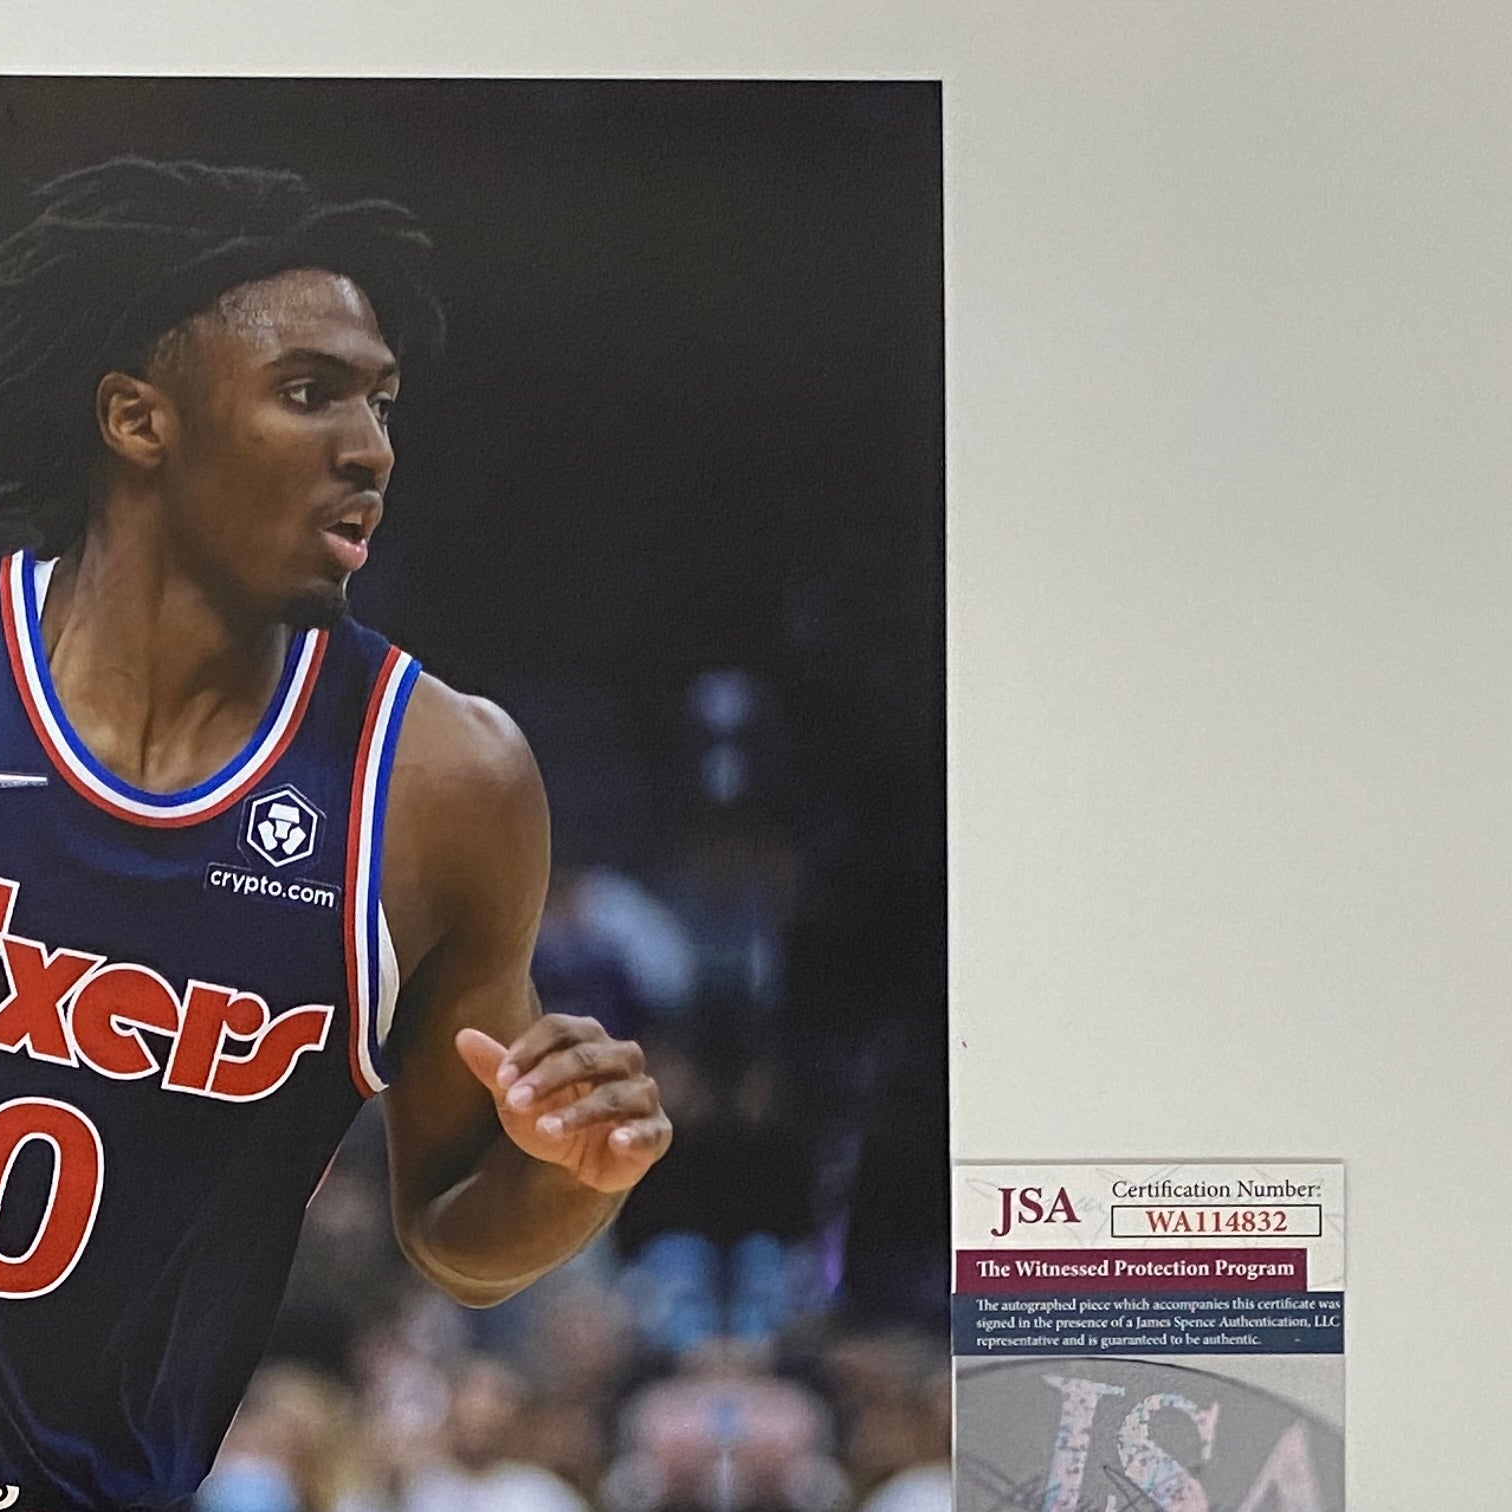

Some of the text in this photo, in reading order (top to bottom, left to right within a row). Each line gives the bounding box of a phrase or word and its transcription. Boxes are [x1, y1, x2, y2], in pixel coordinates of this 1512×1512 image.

[211, 868, 334, 908] crypto.com
[1112, 1179, 1322, 1199] Certification Number:
[991, 1187, 1081, 1236] JSA
[1146, 1210, 1288, 1233] WA114832
[976, 1259, 1295, 1281] The Witnessed Protection Program
[976, 1297, 1340, 1314] The autographed piece which accompanies this certificate was
[976, 1315, 1340, 1332] signed in the presence of a James Spence Authentication, LLC
[976, 1333, 1262, 1349] representative and is guaranteed to be authentic.
